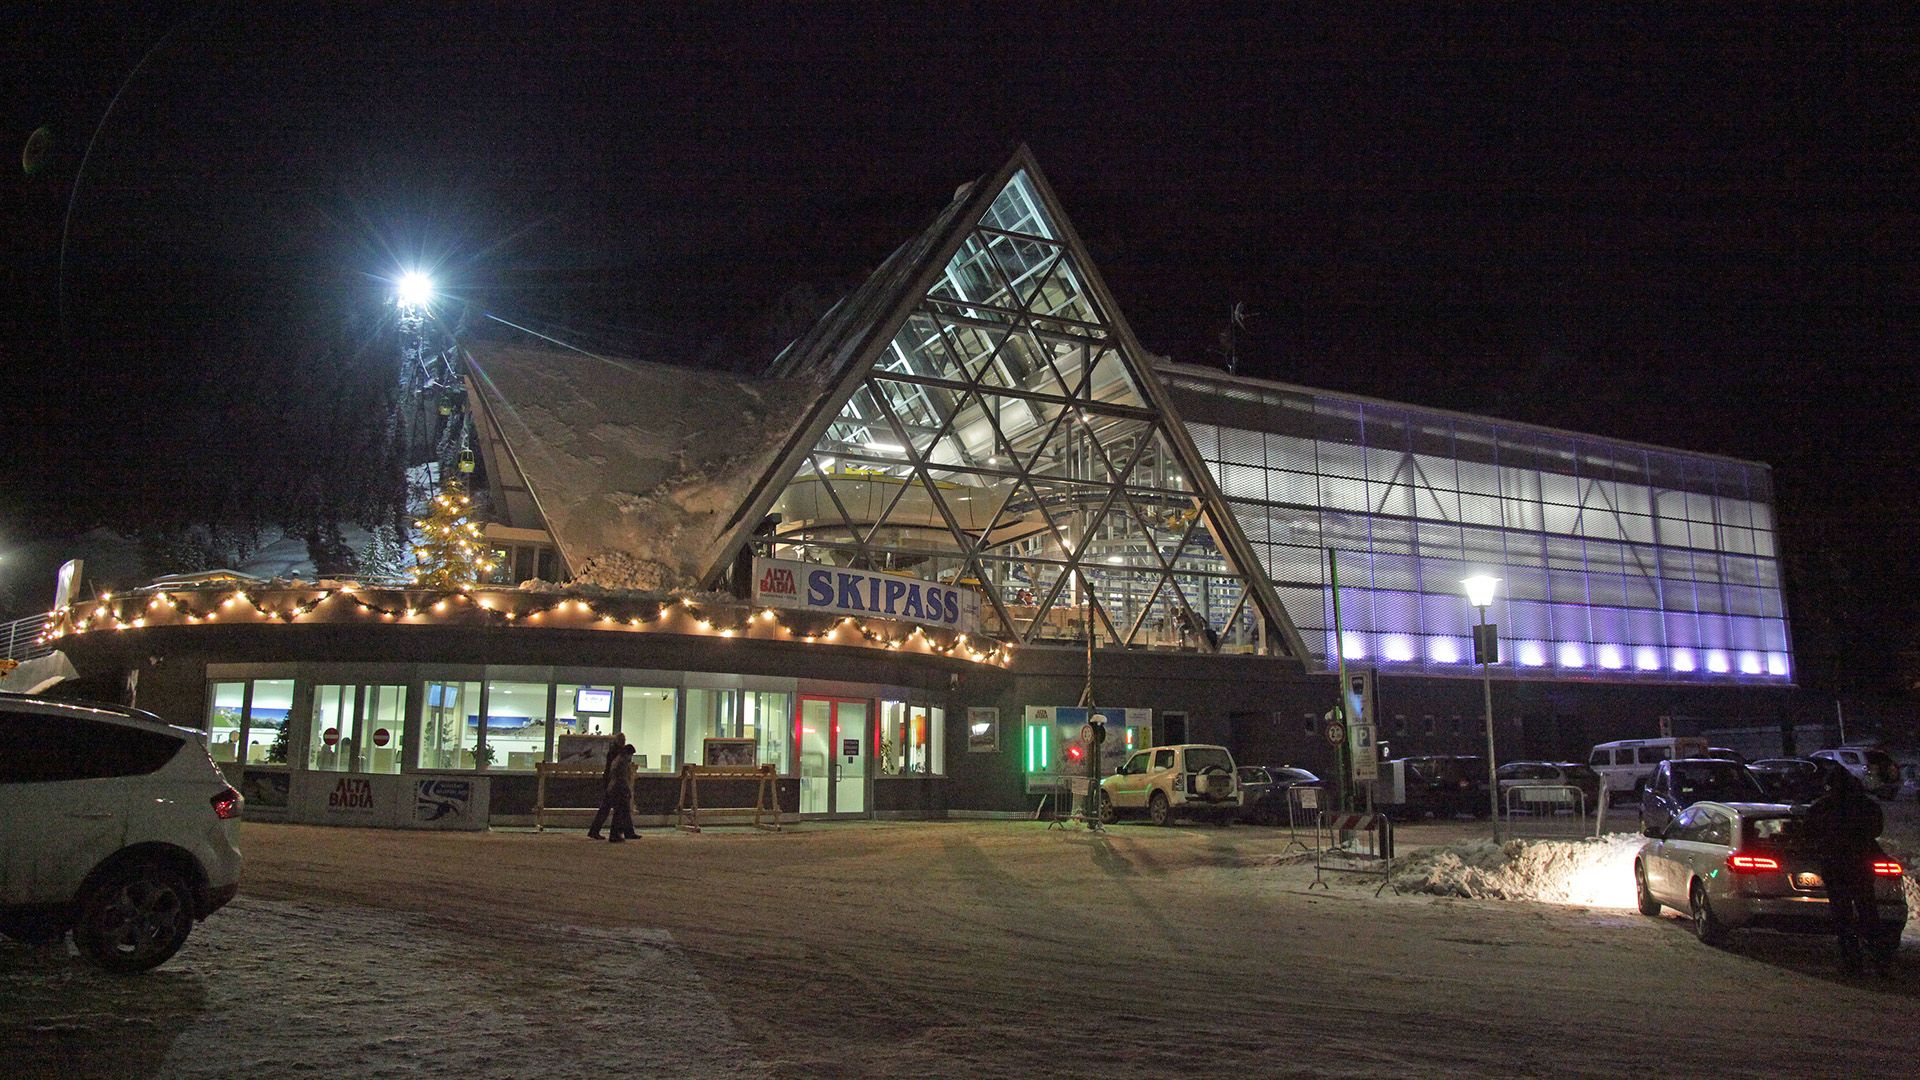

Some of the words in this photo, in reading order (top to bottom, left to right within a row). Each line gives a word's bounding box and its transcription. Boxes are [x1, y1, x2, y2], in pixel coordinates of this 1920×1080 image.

[765, 567, 795, 581] ALTA
[760, 579, 797, 594] BADIA
[807, 569, 959, 624] SKIPASS
[335, 778, 372, 793] ALTA
[329, 792, 374, 808] BADIA
